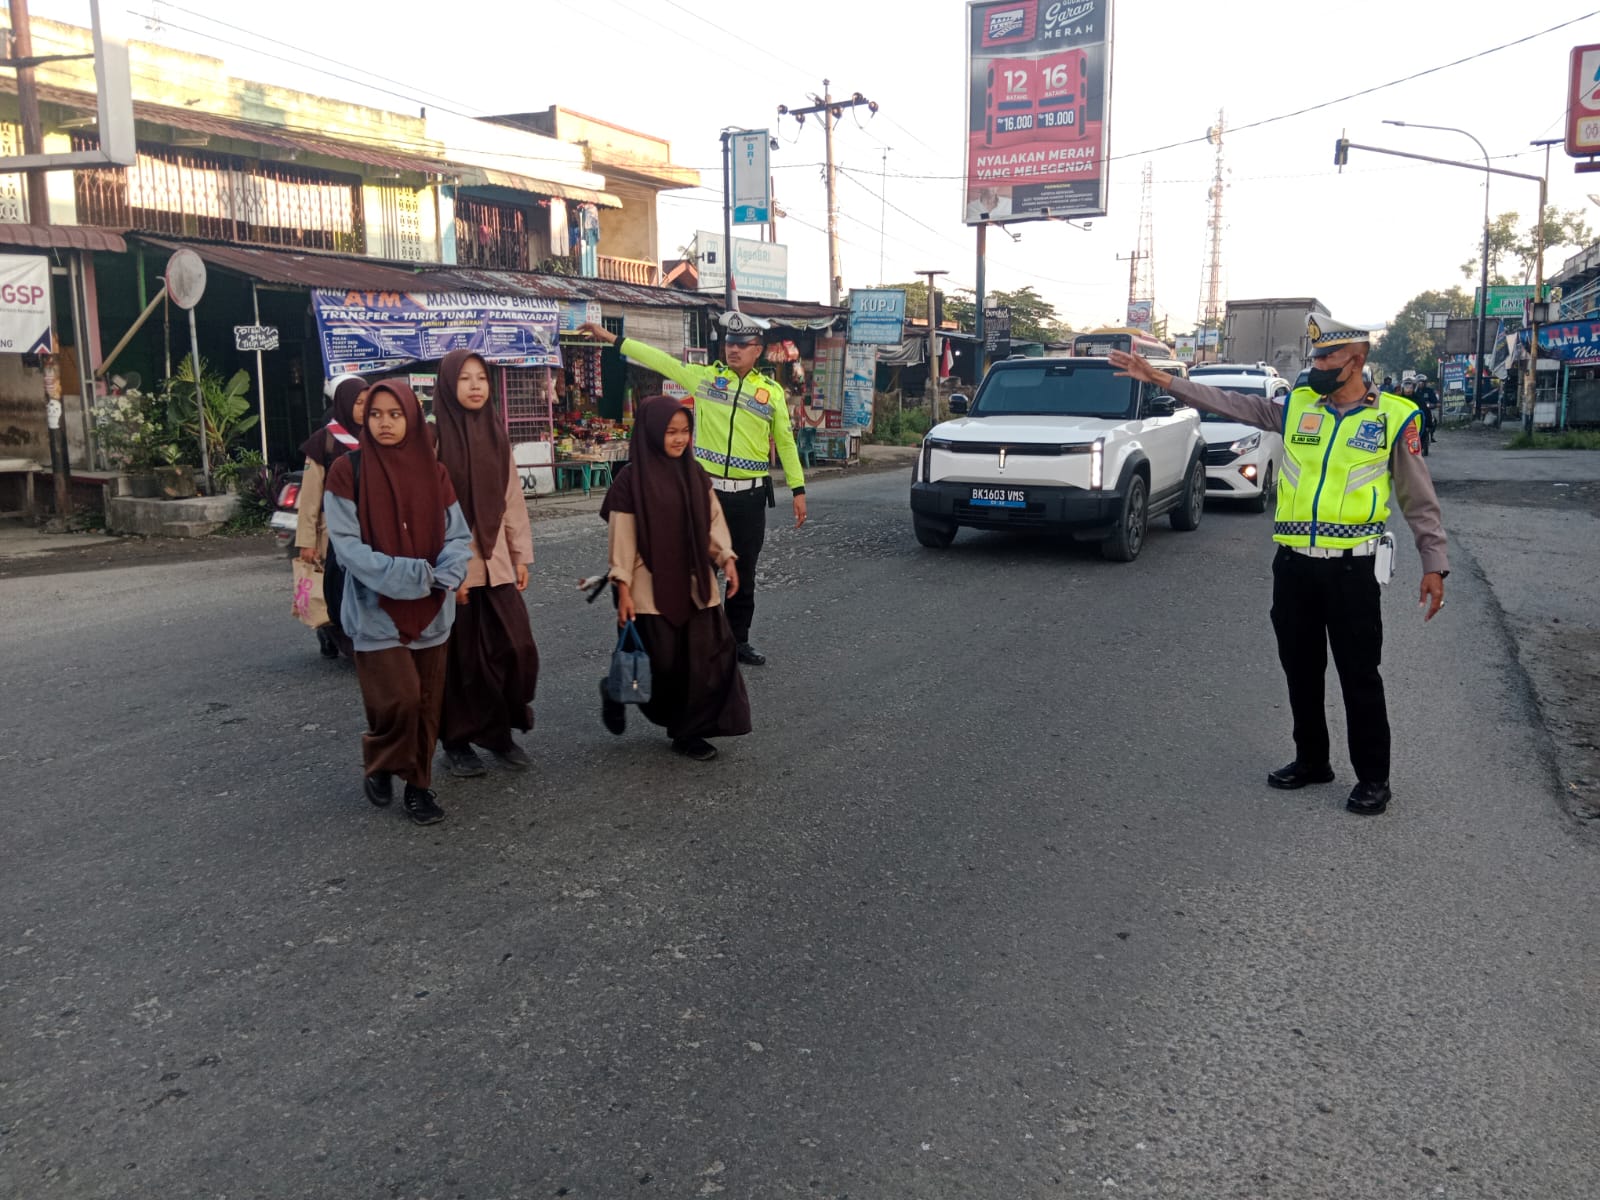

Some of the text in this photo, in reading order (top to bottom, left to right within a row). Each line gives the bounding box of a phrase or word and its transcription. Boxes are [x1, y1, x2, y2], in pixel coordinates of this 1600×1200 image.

[1045, 1, 1095, 29] Garam
[1044, 24, 1093, 39] MERAH
[1003, 70, 1028, 93] 12
[1042, 63, 1068, 91] 16
[1004, 115, 1033, 132] 16.000
[1044, 111, 1074, 127] 19.000
[976, 147, 1095, 168] NYALAKAN MERAH
[976, 161, 1093, 180] YANG MELEGENDA
[343, 290, 402, 308] ATM
[426, 292, 559, 310] MANURUNG BRILINK
[860, 298, 896, 312] KUPJ
[321, 310, 390, 321] TRANSFER
[402, 311, 438, 321] TARIK
[442, 311, 477, 319] TUNAI
[489, 311, 557, 321] PEMBAYARAN
[1547, 326, 1586, 347] RM.
[1348, 439, 1378, 452] POLRI
[972, 488, 1025, 502] BK1603 VMS
